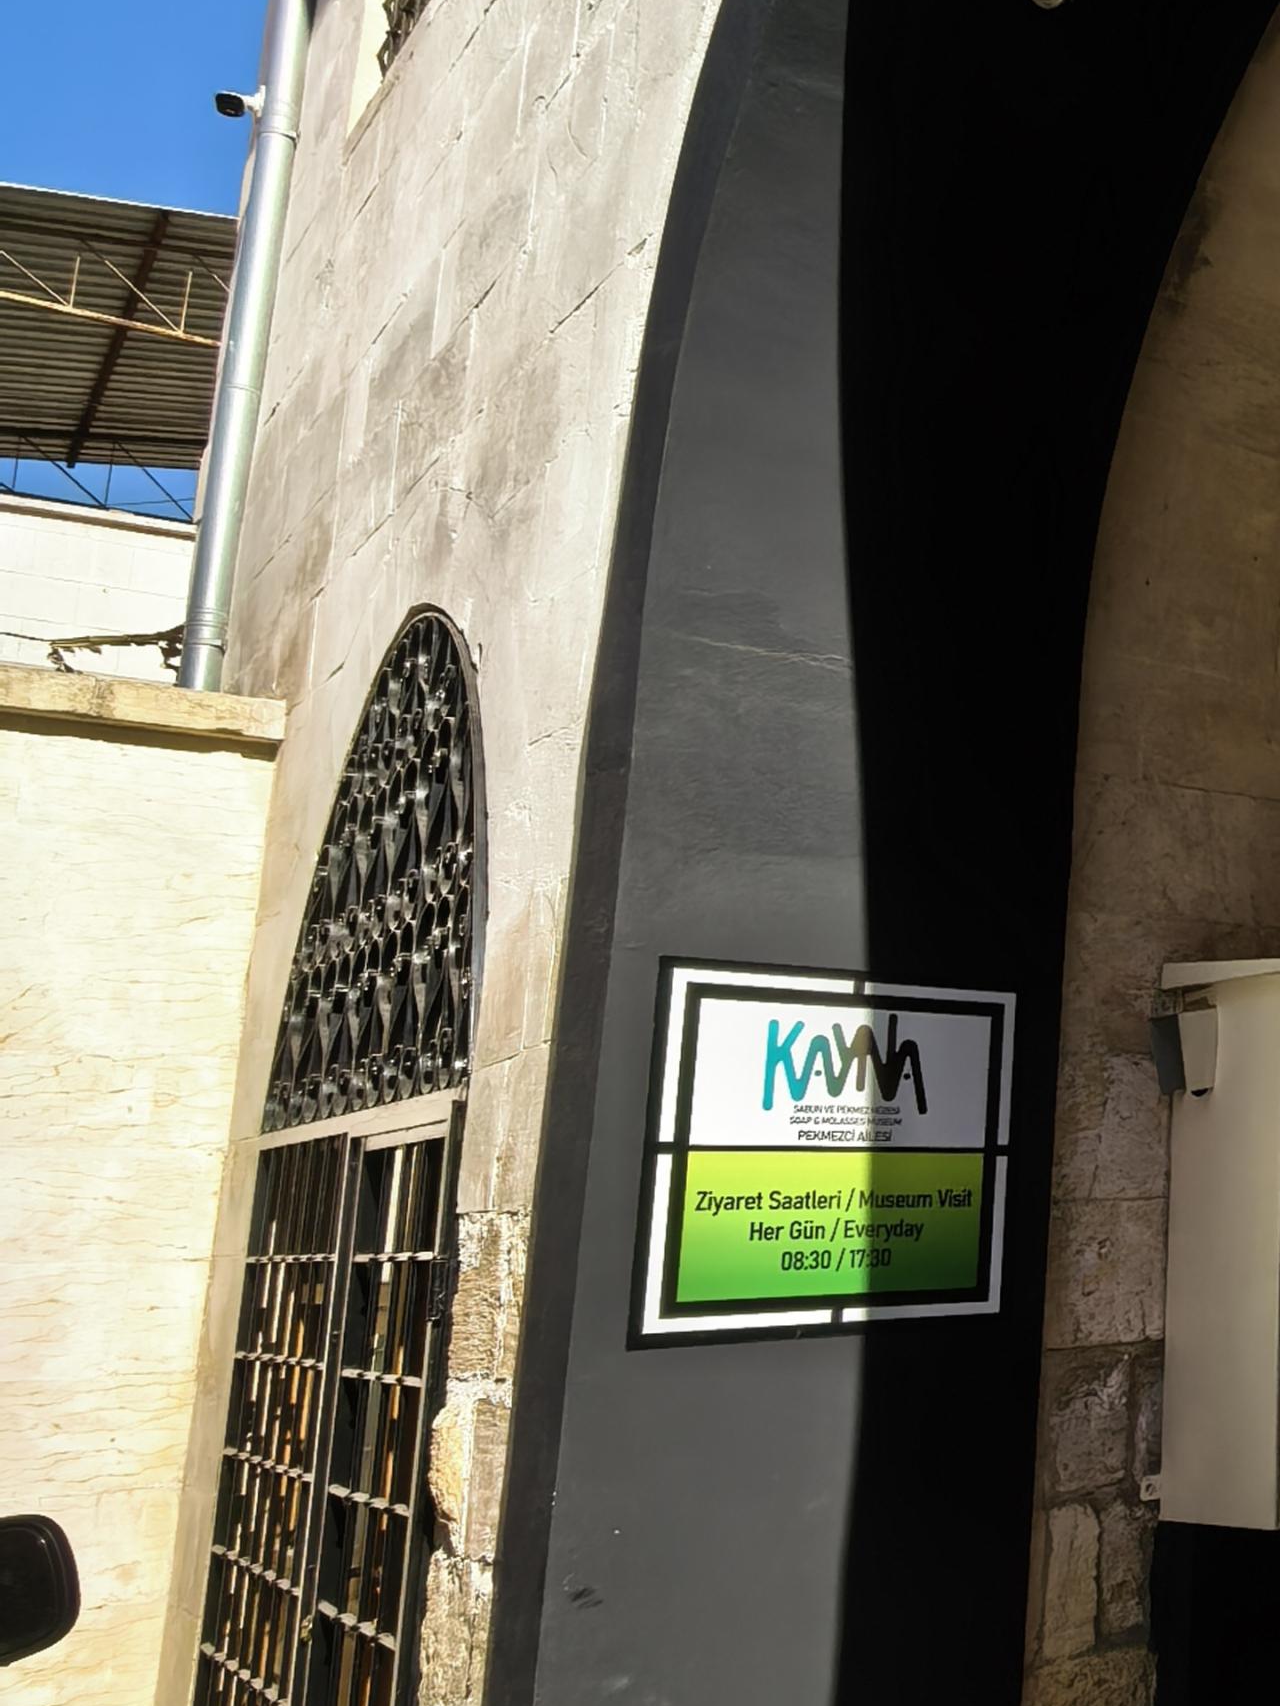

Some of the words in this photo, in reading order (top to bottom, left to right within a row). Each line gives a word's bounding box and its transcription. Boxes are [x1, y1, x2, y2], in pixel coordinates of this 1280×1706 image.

[798, 1129, 856, 1142] PEKMEZCİ
[695, 1190, 763, 1216] Ziyaret
[768, 1190, 842, 1211] Saatleri
[845, 1188, 856, 1212] /
[858, 1191, 933, 1209] Museum
[936, 1189, 972, 1209] Visit
[749, 1221, 784, 1241] Her
[789, 1219, 825, 1240] Gün
[829, 1218, 841, 1242] /
[844, 1219, 924, 1242] Everyday
[781, 1250, 832, 1271] 08:30
[835, 1247, 846, 1272] /
[849, 1248, 892, 1269] 17:30
